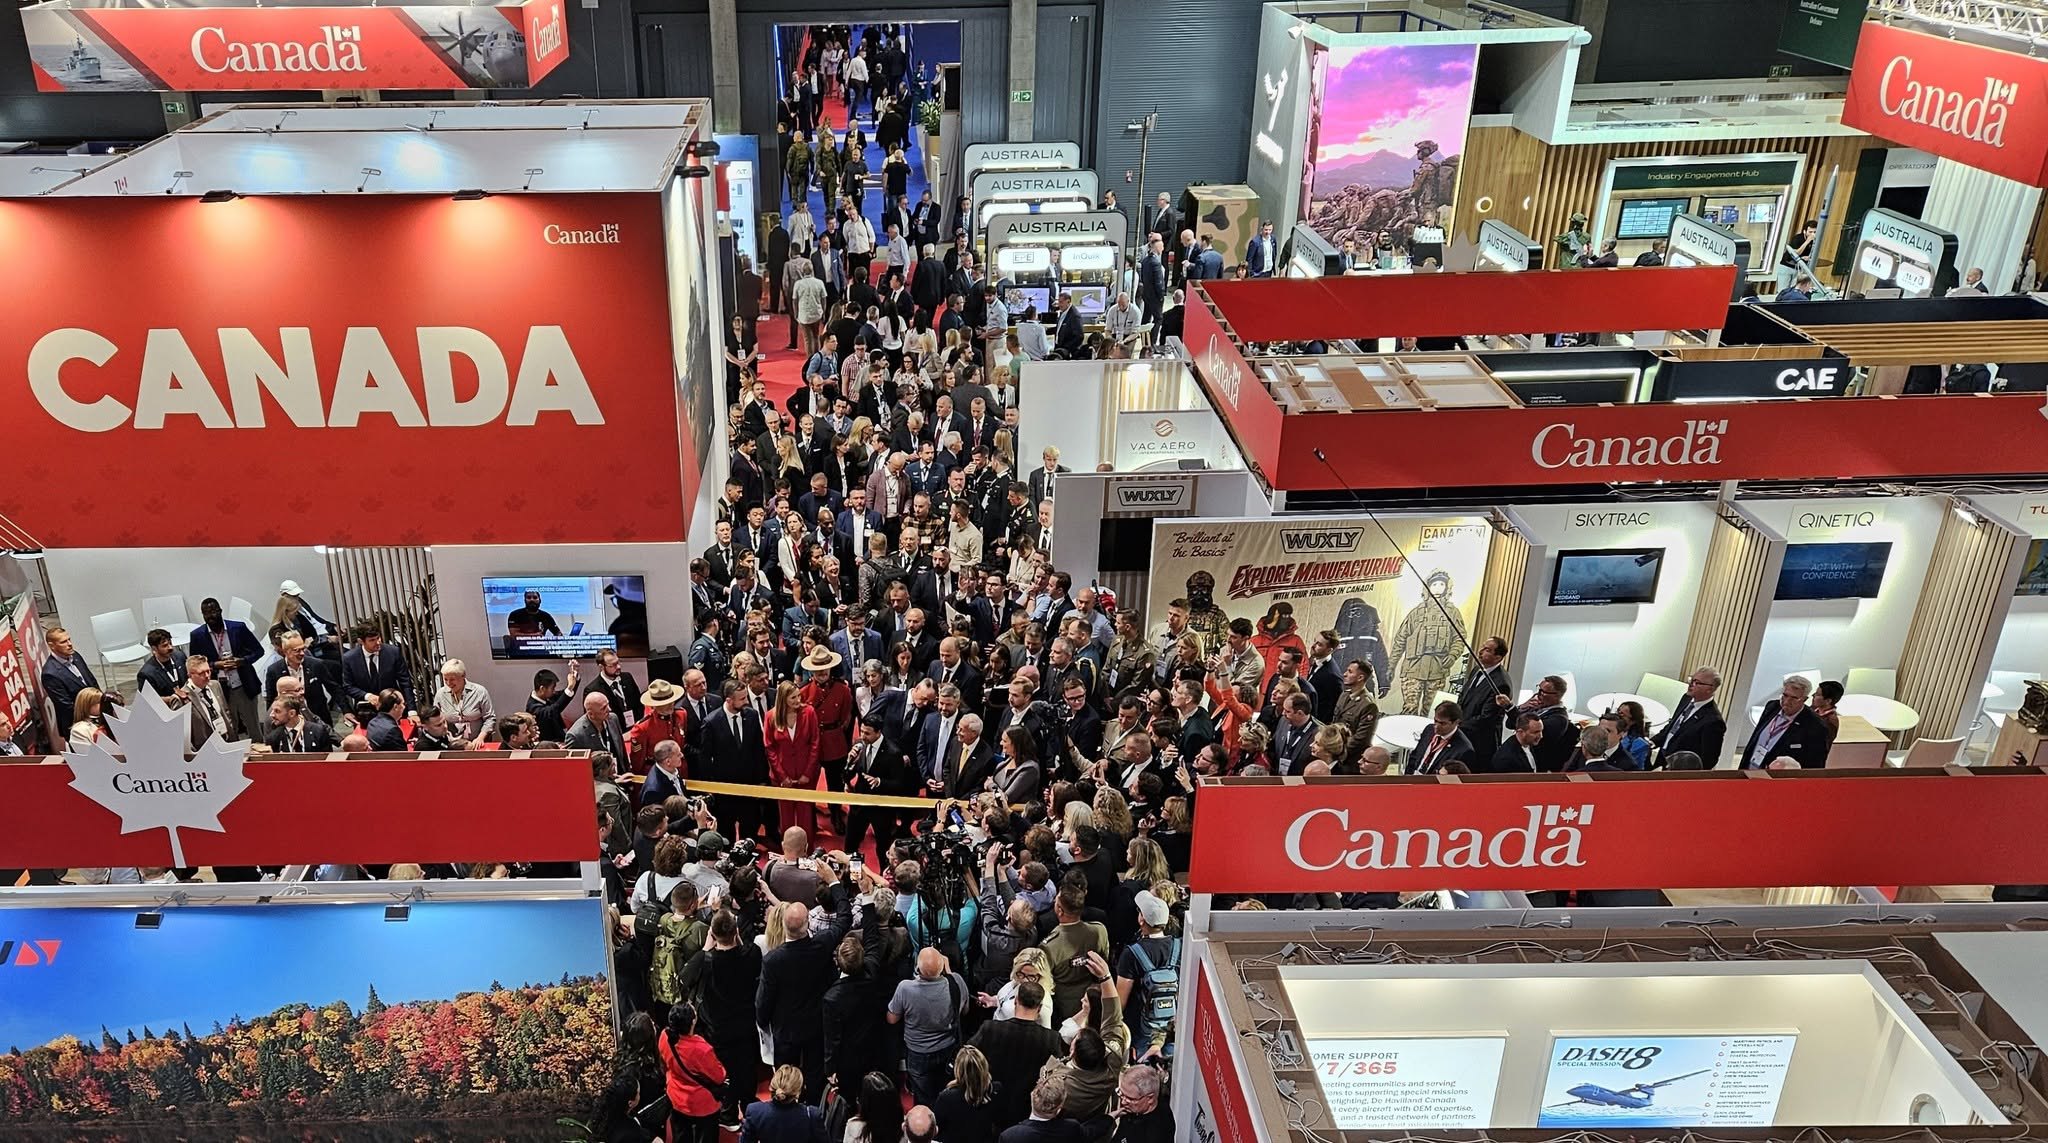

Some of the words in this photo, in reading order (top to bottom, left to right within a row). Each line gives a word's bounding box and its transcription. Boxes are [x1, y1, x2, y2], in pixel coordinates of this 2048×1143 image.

[533, 4, 562, 63] Canada
[191, 25, 367, 73] Canada
[1880, 55, 2019, 148] Canada
[981, 149, 1064, 160] AUSTRALIA
[1648, 173, 1684, 181] Industry
[1684, 171, 1740, 180] Engagement
[1741, 169, 1760, 177] Hub
[991, 178, 1081, 191] AUSTRALIA
[543, 223, 621, 245] Canada
[1007, 220, 1108, 234] AUSTRALIA
[1679, 227, 1729, 260] AUSTRALIA
[1873, 221, 1934, 254] AUSTRALIA
[1486, 232, 1524, 265] AUSTRALIA
[27, 324, 606, 433] CANADA
[1208, 333, 1242, 412] Canada
[1776, 367, 1838, 391] CAE
[1130, 442, 1156, 451] VAC
[1160, 441, 1196, 450] AERO
[1531, 419, 1729, 469] Canada
[1123, 489, 1177, 503] WUXLY
[1575, 512, 1650, 527] SKYTRAC
[1798, 511, 1875, 528] QINETIQ
[1221, 532, 1235, 543] at
[1285, 531, 1360, 549] WUXLY
[1173, 546, 1188, 558] the
[1801, 570, 1858, 580] CONFIDENCE
[1810, 563, 1830, 571] ACT
[1831, 562, 1853, 570] WITH
[1229, 564, 1293, 596] EXPLORE
[1292, 556, 1404, 585] MANUFACTURING
[1273, 591, 1289, 601] WITH
[1290, 589, 1308, 599] YOUR
[1309, 587, 1336, 598] FRIENDS
[1337, 586, 1346, 595] IN
[1346, 583, 1374, 593] CANADA
[0, 649, 18, 678] CA
[4, 671, 24, 702] NA
[10, 692, 31, 724] DA
[112, 772, 211, 794] Canada
[1284, 804, 1595, 871] Canada
[1313, 1052, 1345, 1060] OMER
[1348, 1052, 1399, 1060] SUPPORT
[1559, 1047, 1636, 1061] DASH
[1622, 1046, 1662, 1070] 8
[1352, 1080, 1406, 1088] communities
[1426, 1080, 1457, 1088] serving
[1354, 1089, 1399, 1097] supporting
[1400, 1089, 1430, 1097] special
[1362, 1105, 1392, 1113] aircraft
[1441, 1113, 1476, 1121] partners
